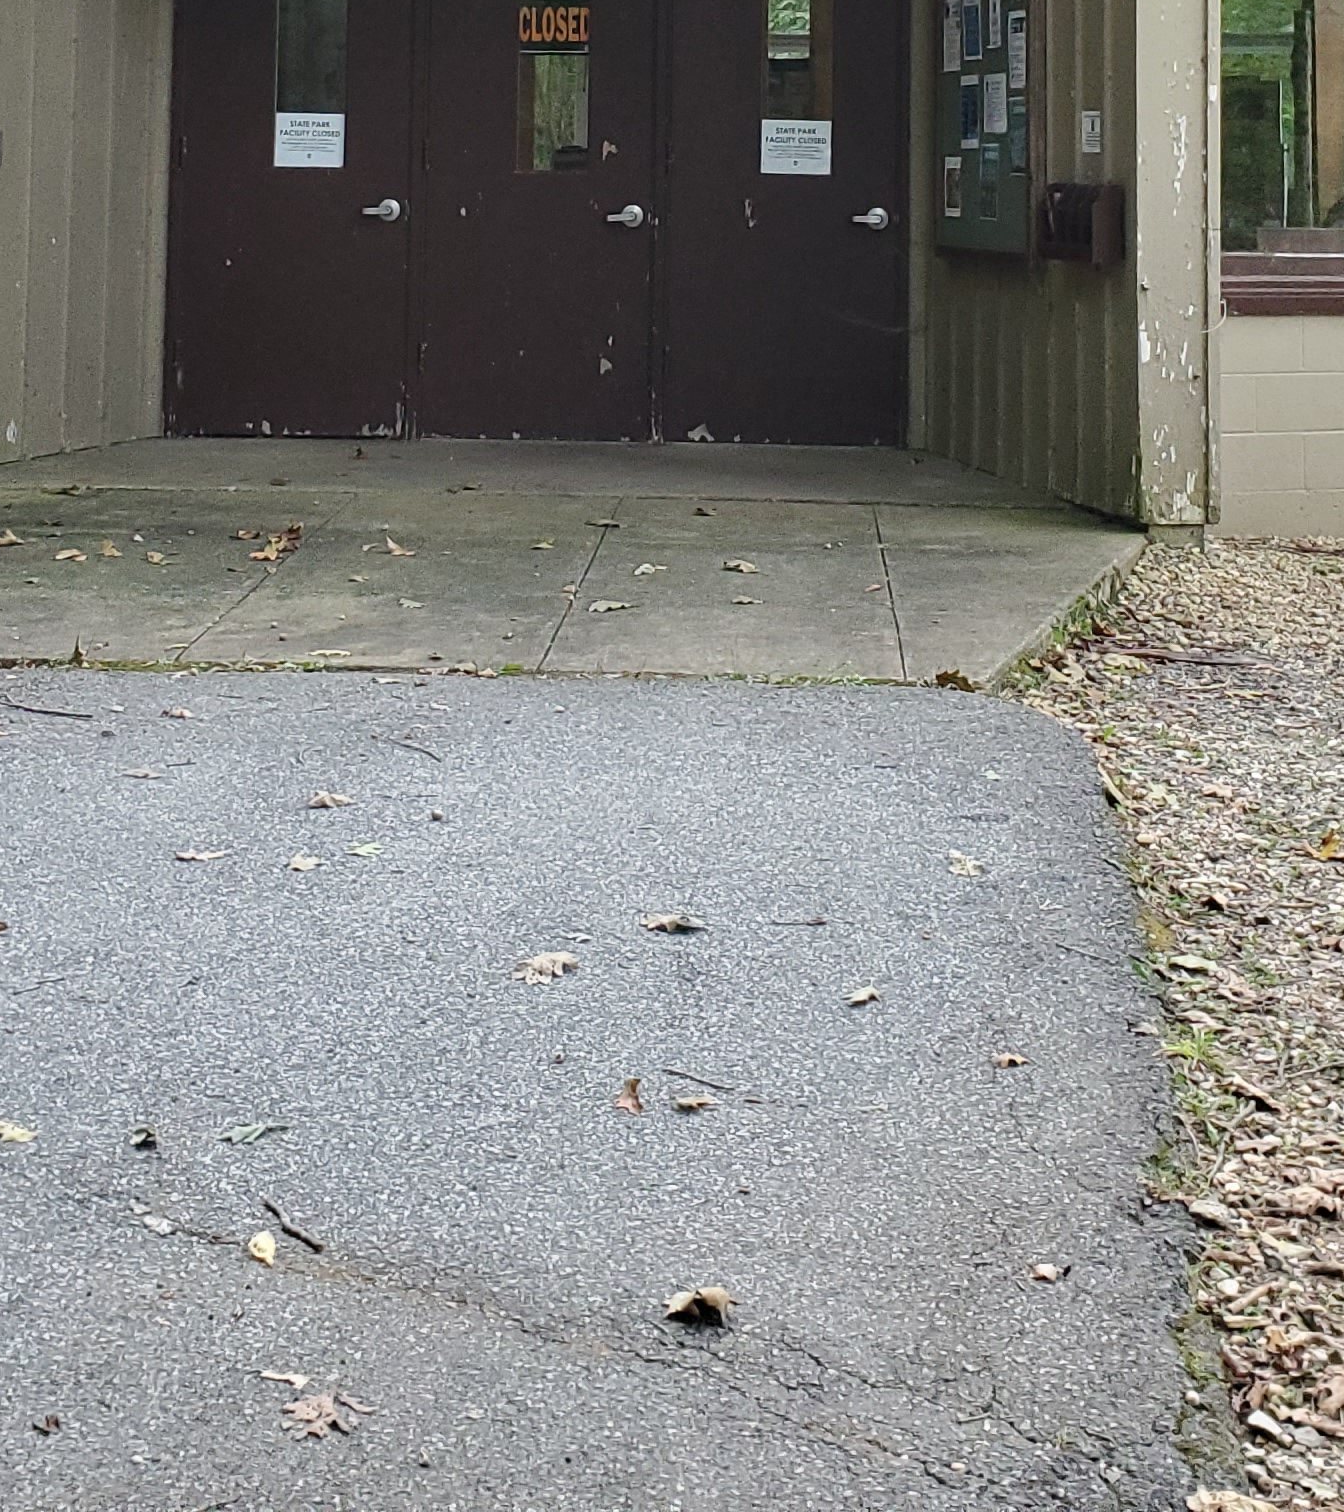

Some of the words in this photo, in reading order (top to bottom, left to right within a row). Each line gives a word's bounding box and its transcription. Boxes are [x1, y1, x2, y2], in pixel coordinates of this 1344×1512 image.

[519, 6, 589, 42] CLOSED
[290, 120, 310, 128] STATE
[280, 129, 310, 137] FACILITY
[312, 130, 341, 138] CLOSED
[776, 127, 796, 135] STATE
[797, 128, 817, 136] PARK
[798, 137, 827, 145] CLOSED
